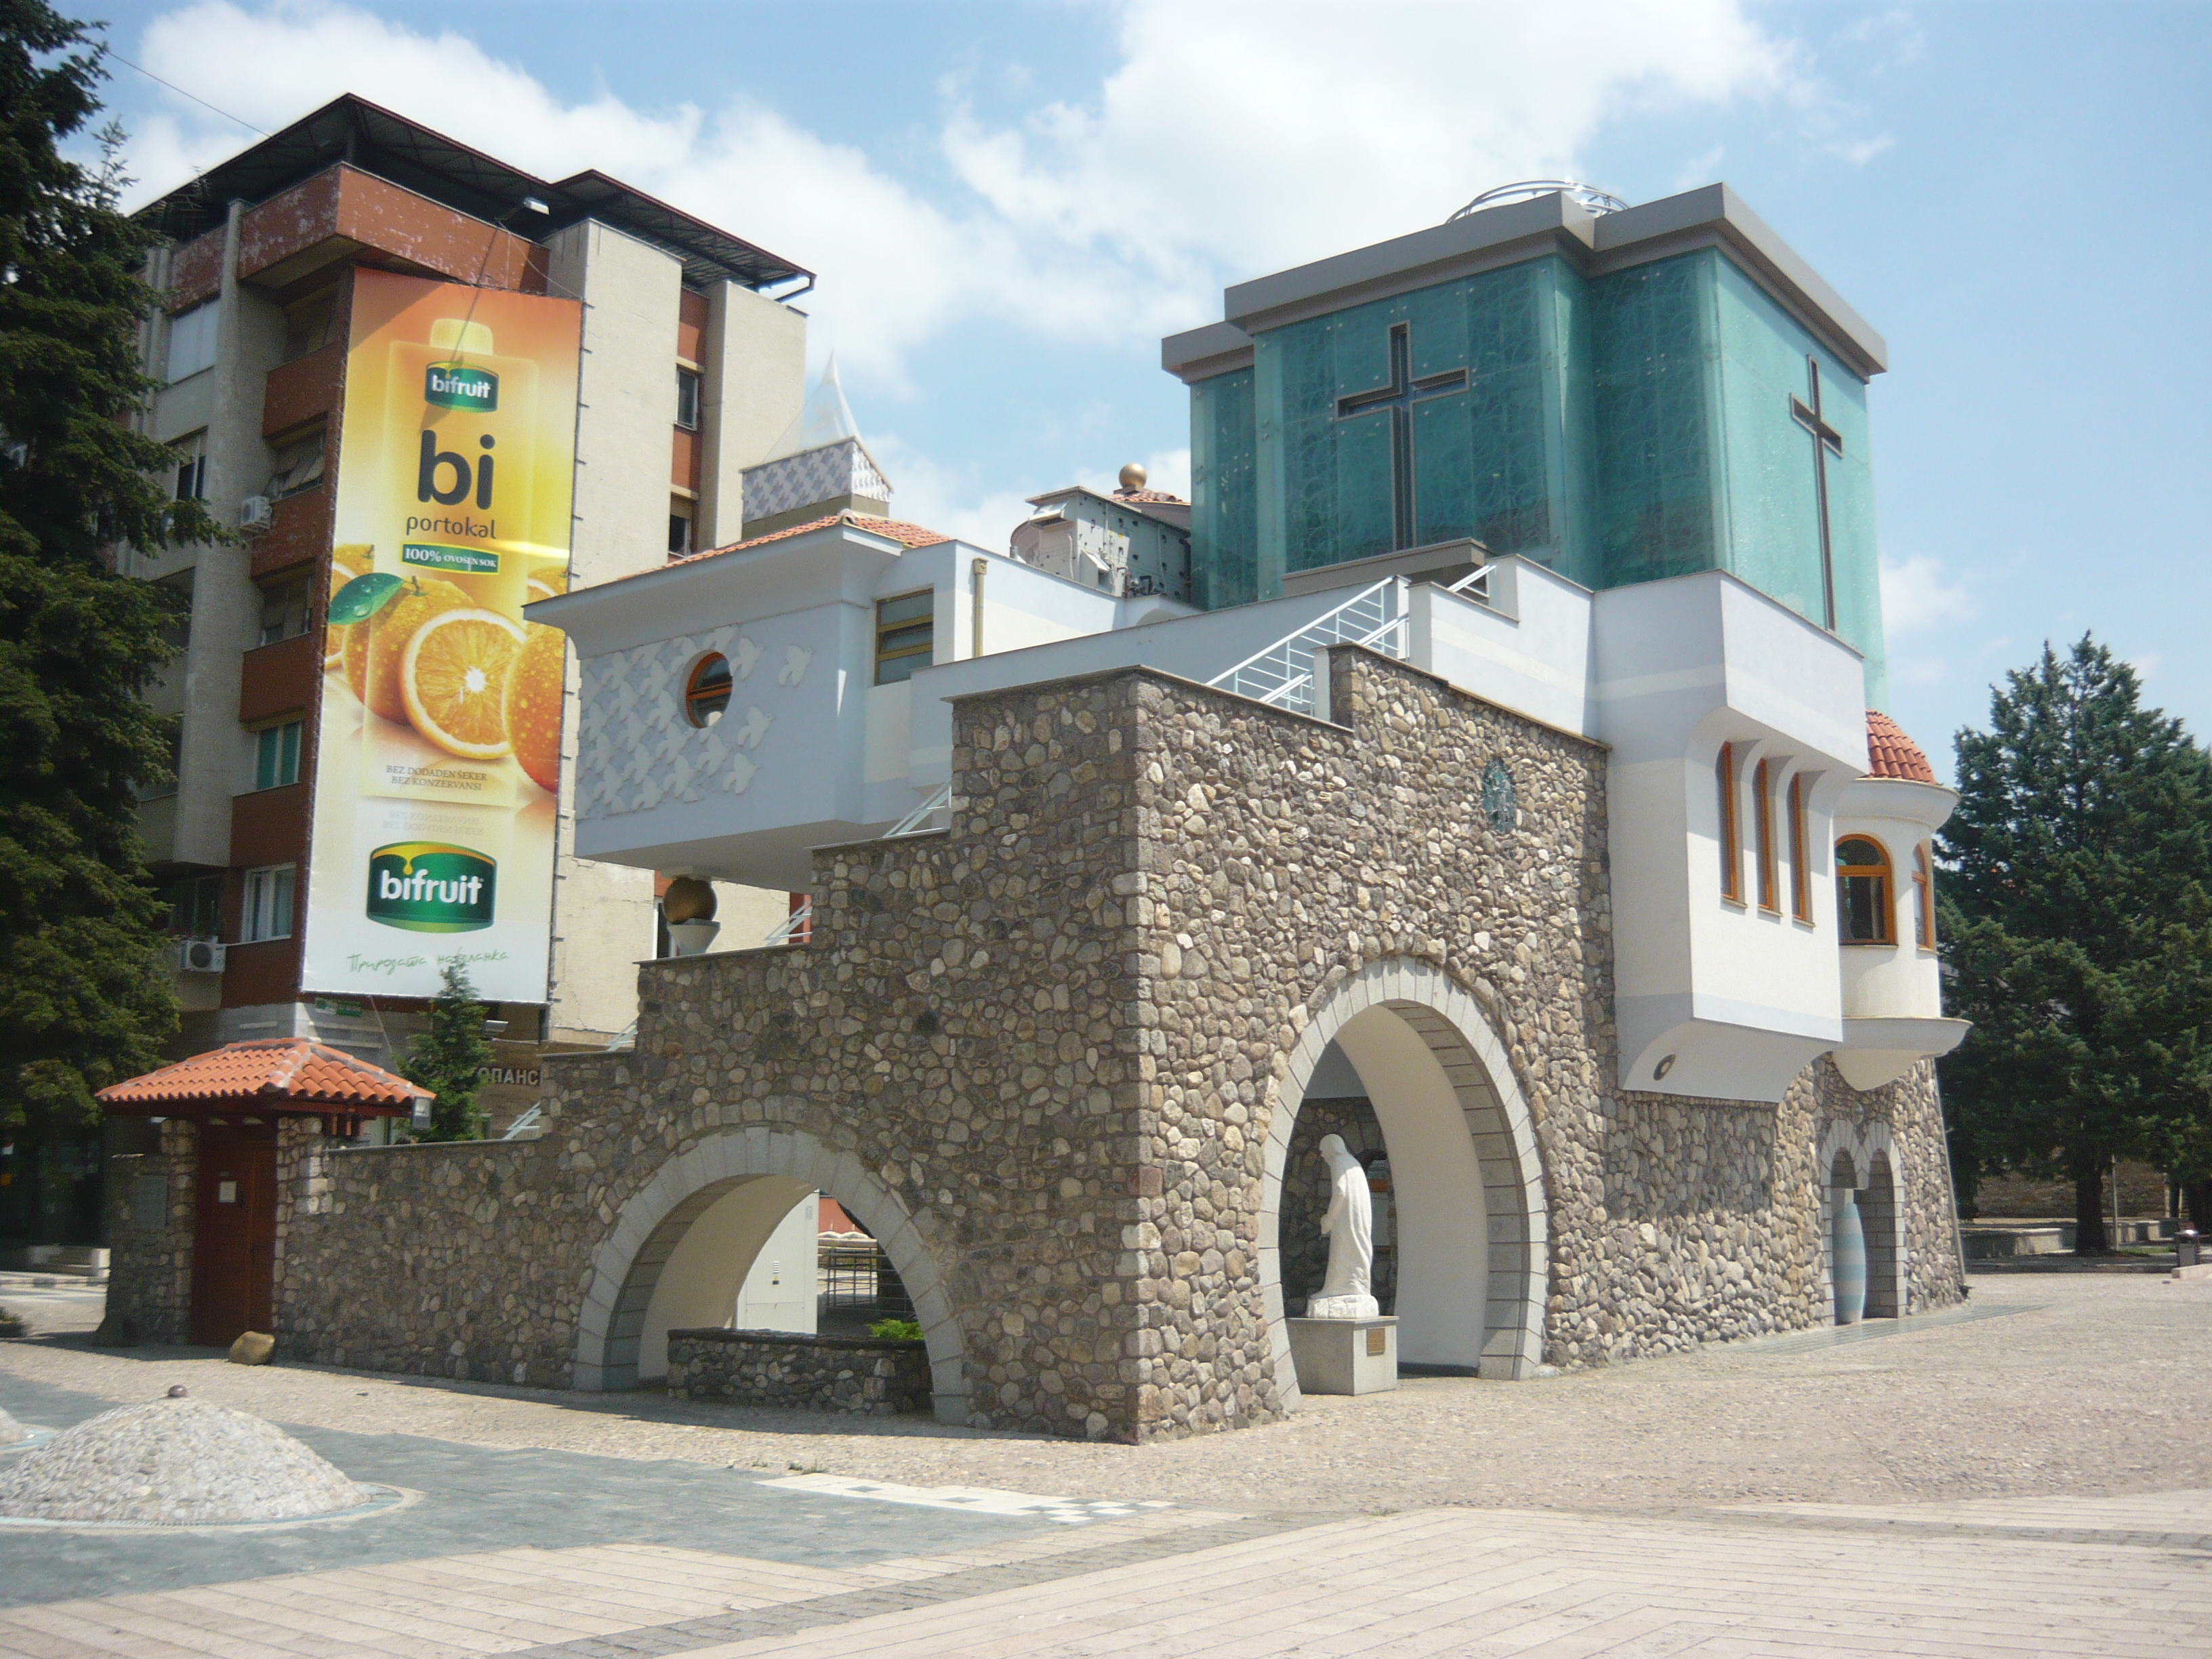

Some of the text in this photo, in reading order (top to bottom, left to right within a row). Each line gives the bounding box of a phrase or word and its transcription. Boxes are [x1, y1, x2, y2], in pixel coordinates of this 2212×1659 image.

[432, 375, 491, 398] bifruit
[417, 429, 495, 510] bi
[406, 516, 497, 539] portokal
[405, 548, 442, 563] 100%
[480, 558, 497, 568] SOK
[386, 764, 406, 775] BEZ
[407, 766, 455, 778] DODADEN
[391, 775, 482, 791] BEZ KONZERVANSI
[381, 869, 483, 905] bifruit
